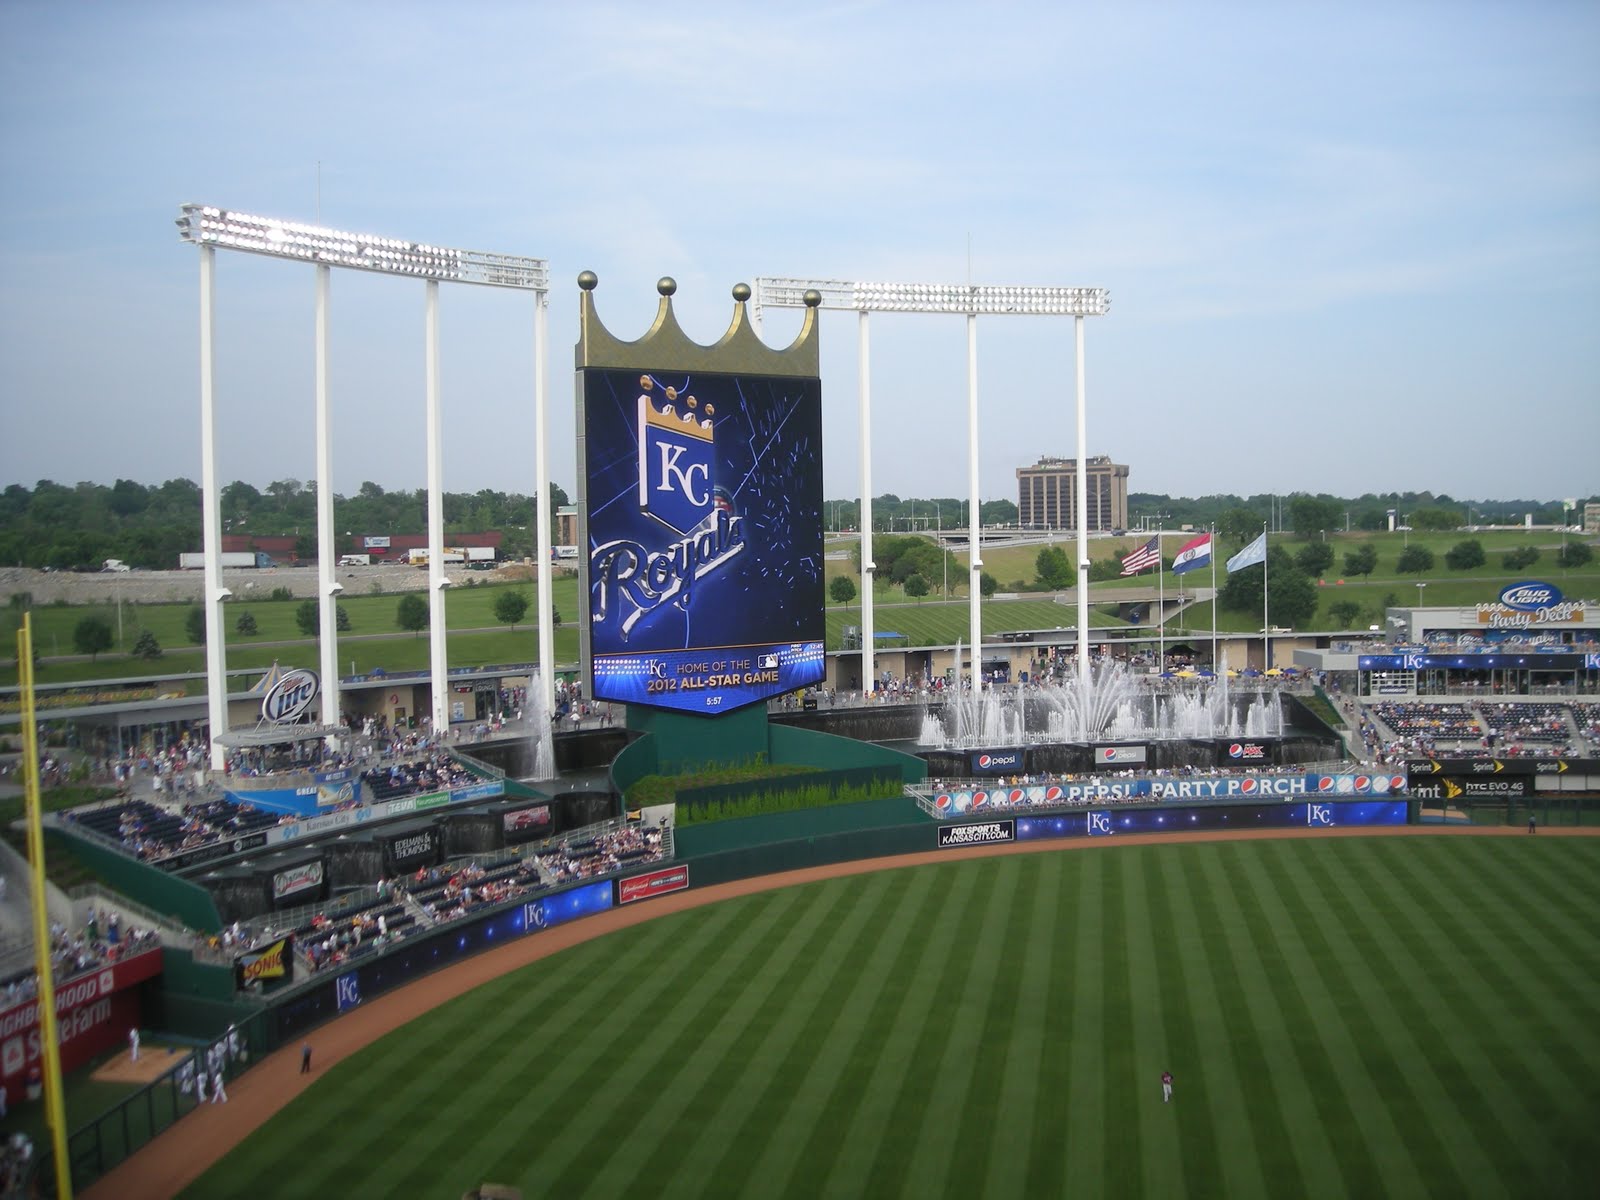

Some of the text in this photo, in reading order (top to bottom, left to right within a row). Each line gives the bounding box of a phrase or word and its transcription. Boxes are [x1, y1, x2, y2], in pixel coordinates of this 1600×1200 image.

[656, 441, 709, 506] KC
[1510, 596, 1552, 604] LIGHT
[1489, 606, 1572, 630] Party Deck
[650, 659, 666, 678] KC
[677, 659, 750, 674] HOME OF THE
[1408, 655, 1422, 669] KC
[648, 671, 779, 691] 2012 ALL-STAR GAME
[706, 697, 722, 705] 5:57
[992, 756, 1016, 765] pepsi
[1411, 763, 1432, 772] Sprint
[1473, 763, 1494, 772] Sprint
[1536, 763, 1558, 771] Sprint
[1069, 784, 1130, 799] PEPSI
[1152, 781, 1220, 797] PARTY
[1511, 782, 1524, 790] 4G
[1312, 804, 1330, 823] KC
[1092, 813, 1109, 832] KC
[395, 835, 424, 850] EDELMAN
[396, 844, 431, 859] THOMPSON
[529, 904, 543, 925] KC
[246, 952, 281, 977] SONIC
